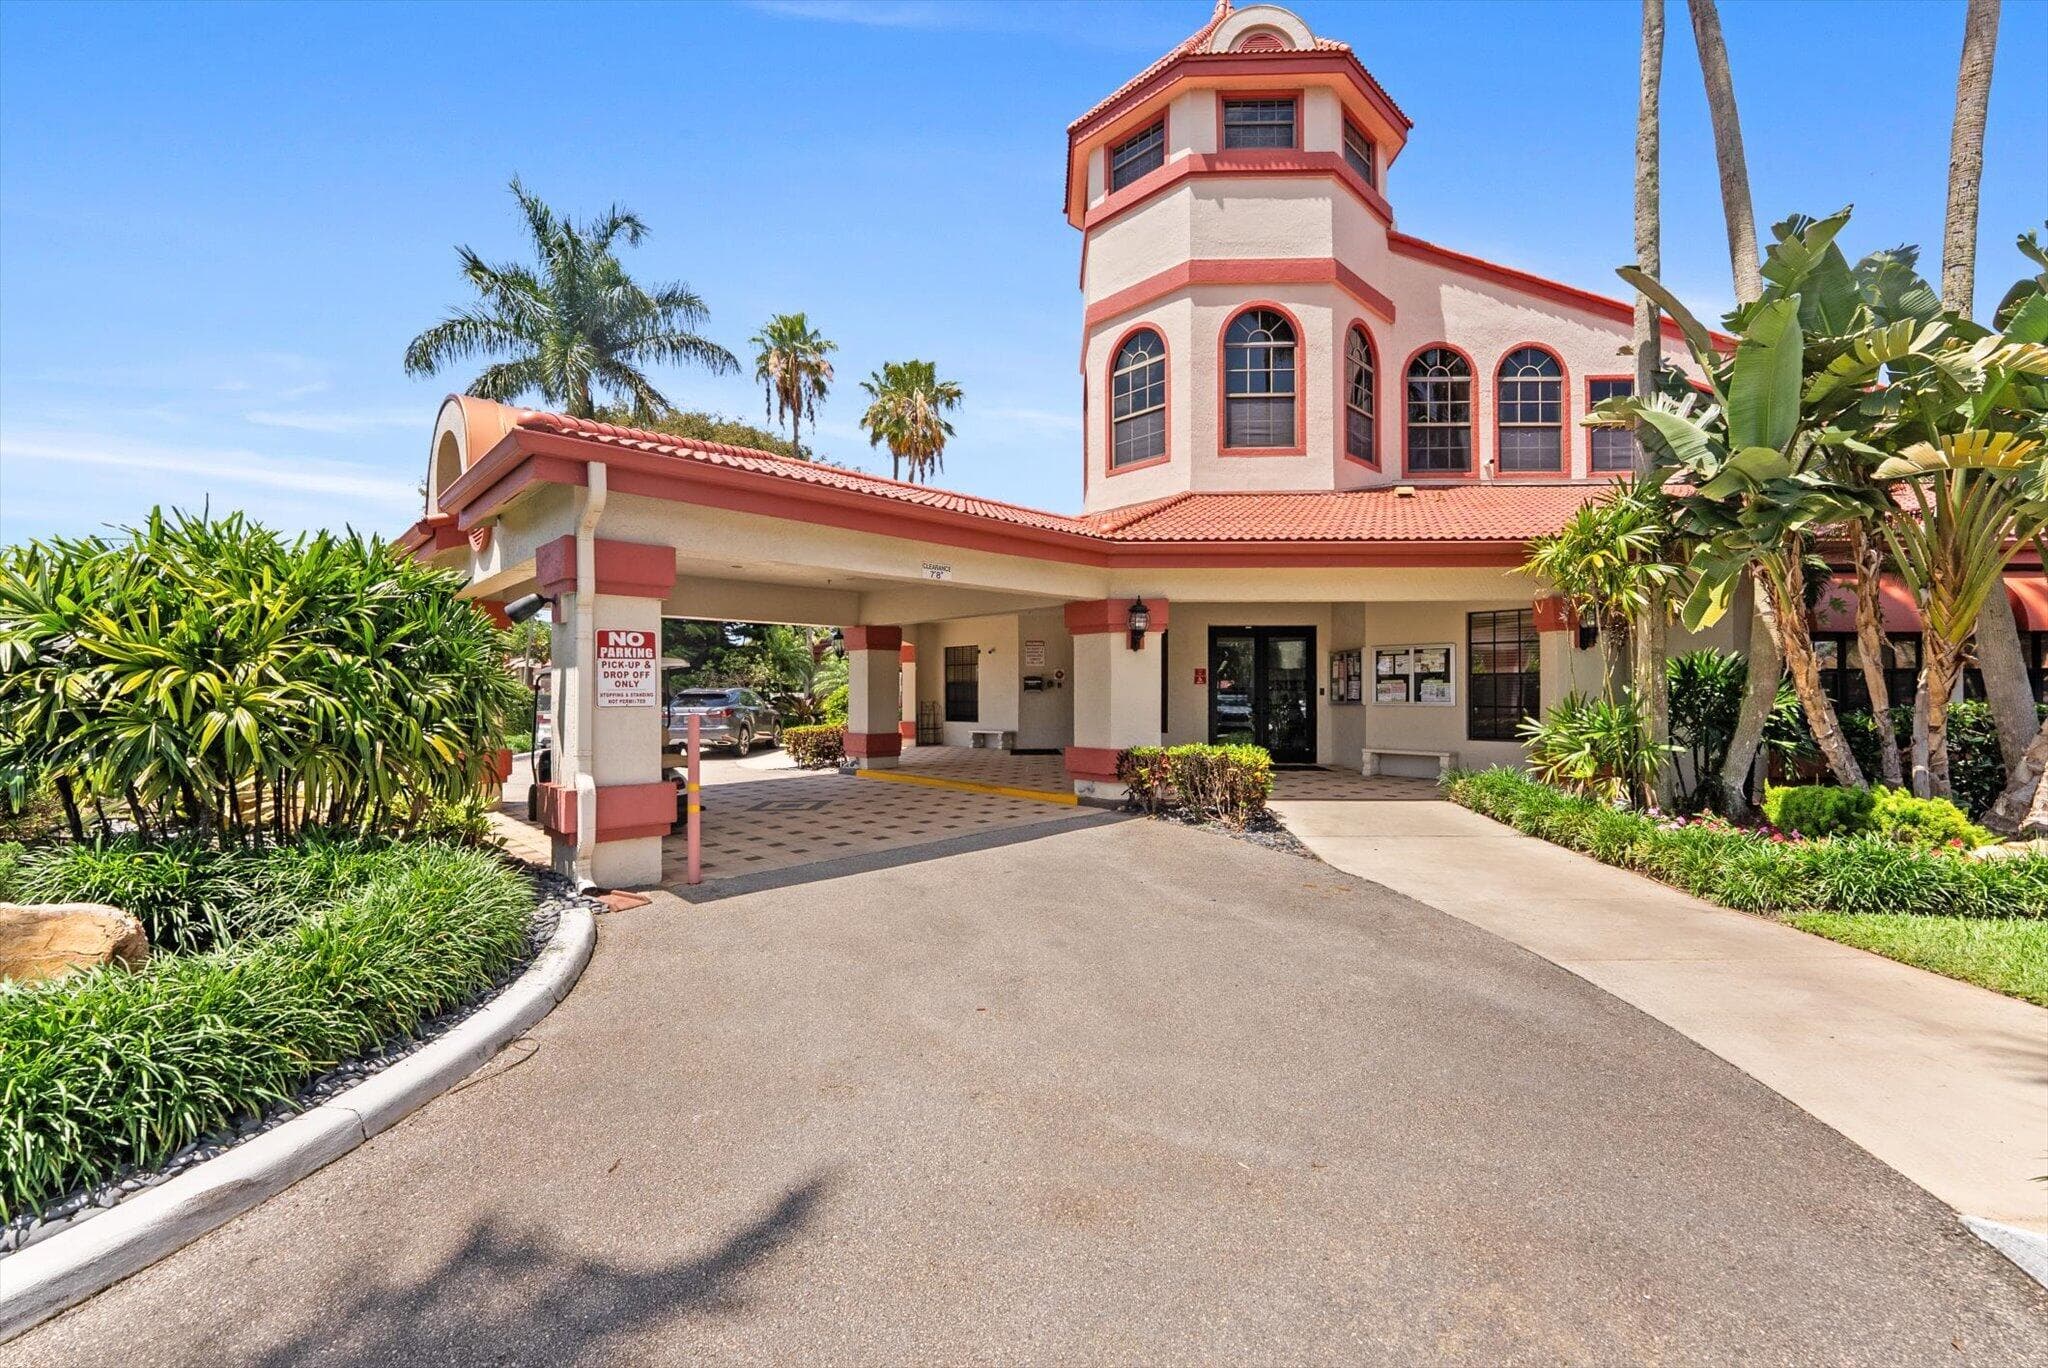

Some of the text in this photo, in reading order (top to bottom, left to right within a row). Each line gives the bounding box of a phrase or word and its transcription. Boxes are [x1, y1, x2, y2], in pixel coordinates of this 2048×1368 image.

[608, 631, 645, 647] NO
[600, 647, 653, 658] PARKING
[601, 660, 651, 668] PICK-UP &
[603, 671, 650, 679] DROP OFF
[614, 680, 640, 688] ONLY
